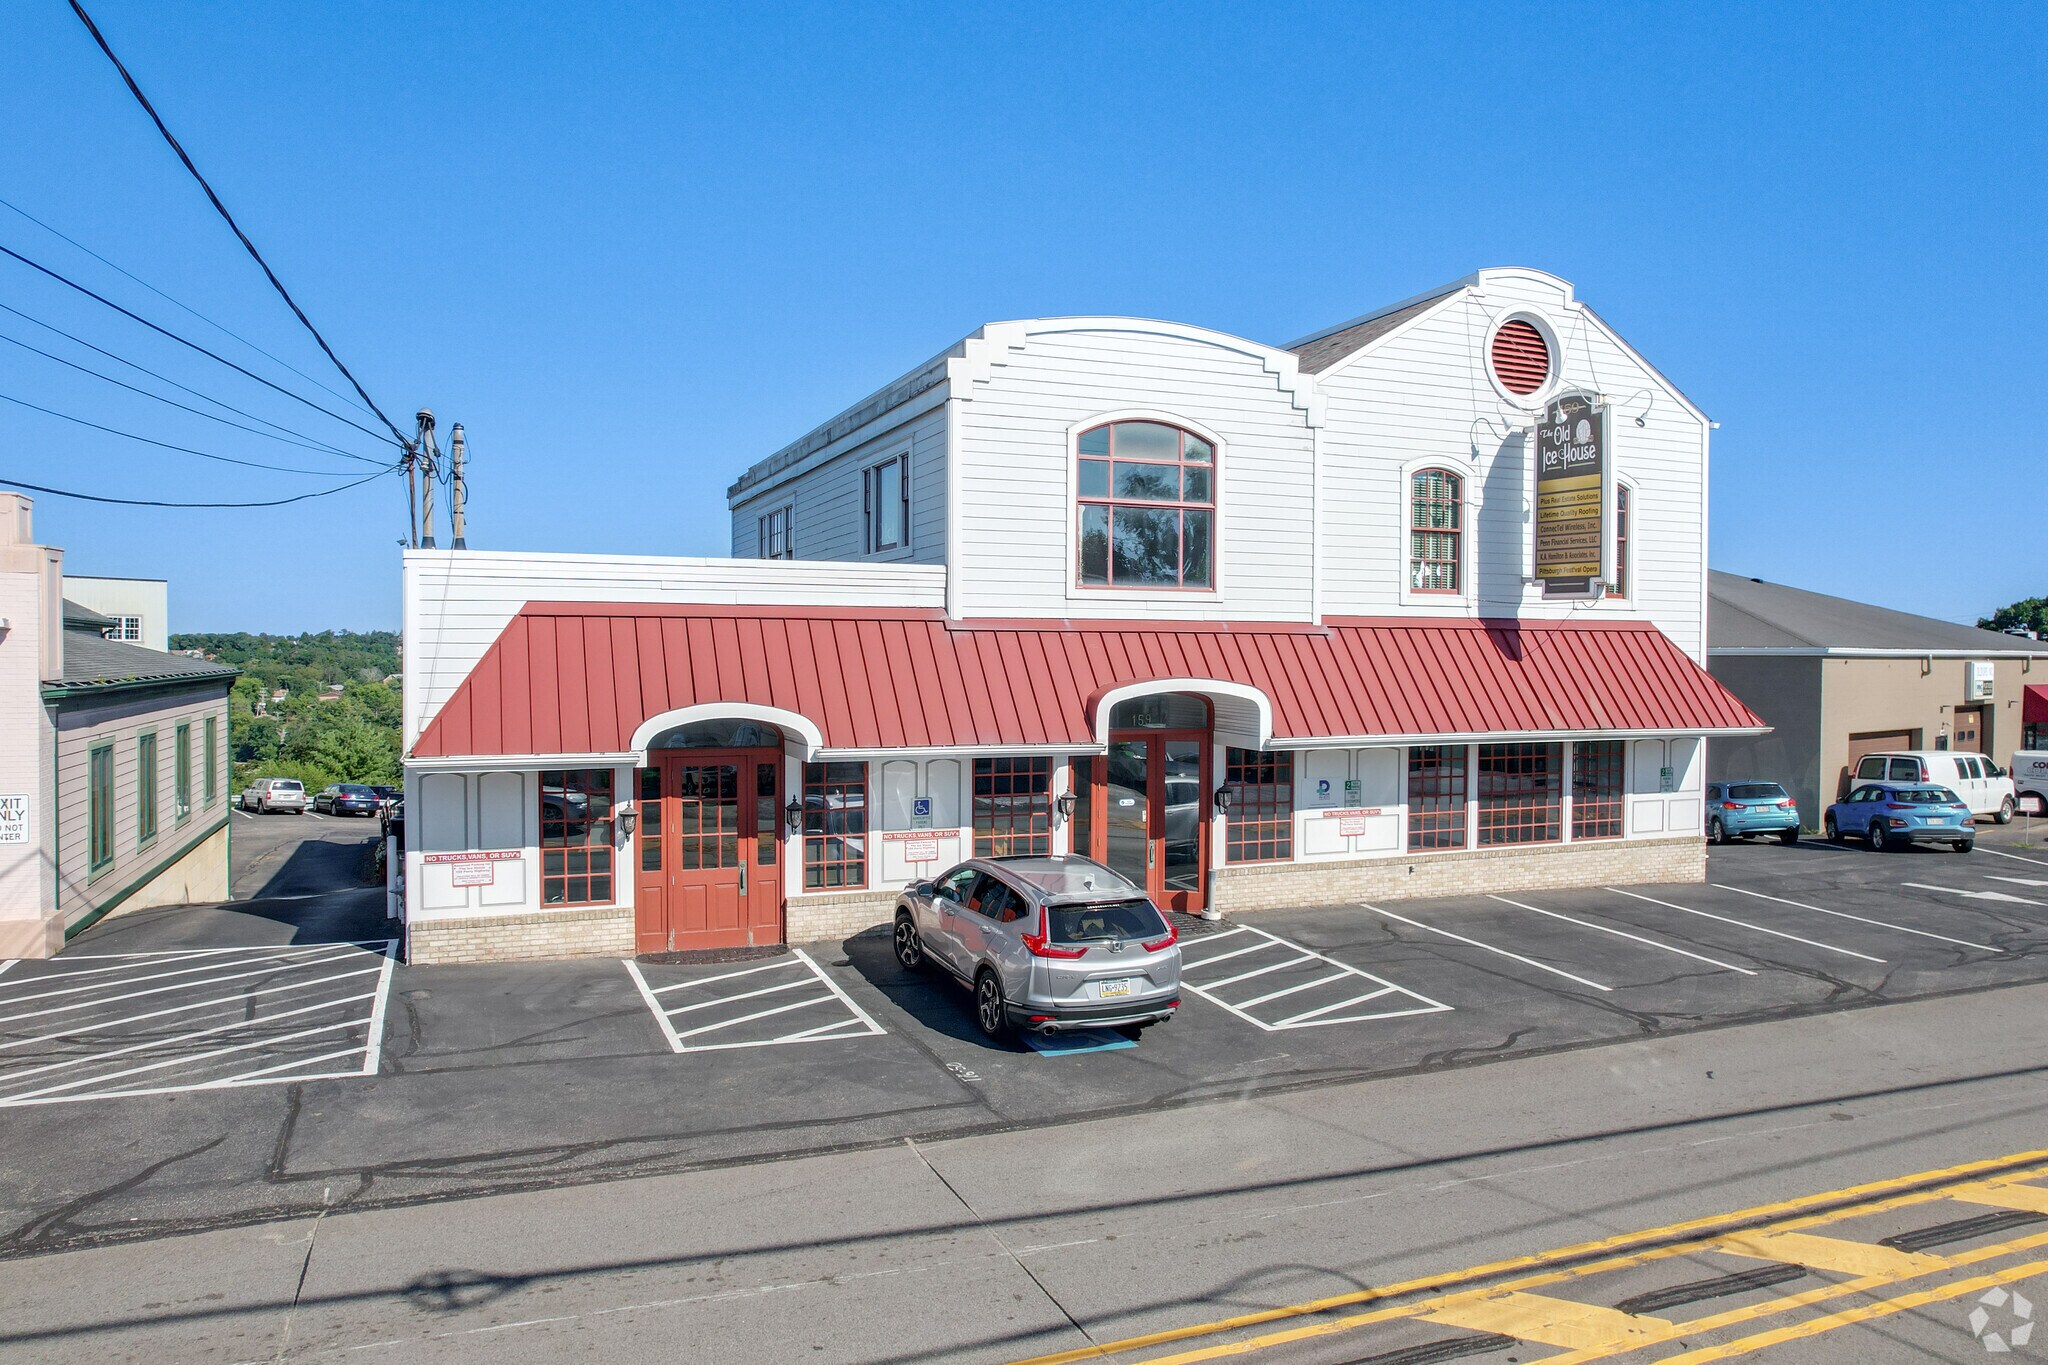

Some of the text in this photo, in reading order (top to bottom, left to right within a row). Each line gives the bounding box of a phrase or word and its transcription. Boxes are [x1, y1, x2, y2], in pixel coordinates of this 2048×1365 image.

[1540, 424, 1571, 445] The Old
[1542, 442, 1596, 473] Ice House
[1576, 493, 1599, 501] Solutions
[1578, 507, 1599, 515] Roofing
[1551, 537, 1569, 545] Financial
[1539, 565, 1598, 575] Pittsburgh Festival Opera
[1131, 714, 1152, 727] 159
[2032, 761, 2048, 769] CO
[0, 798, 21, 809] XIT
[0, 810, 24, 821] NLY
[5, 824, 23, 832] NOT
